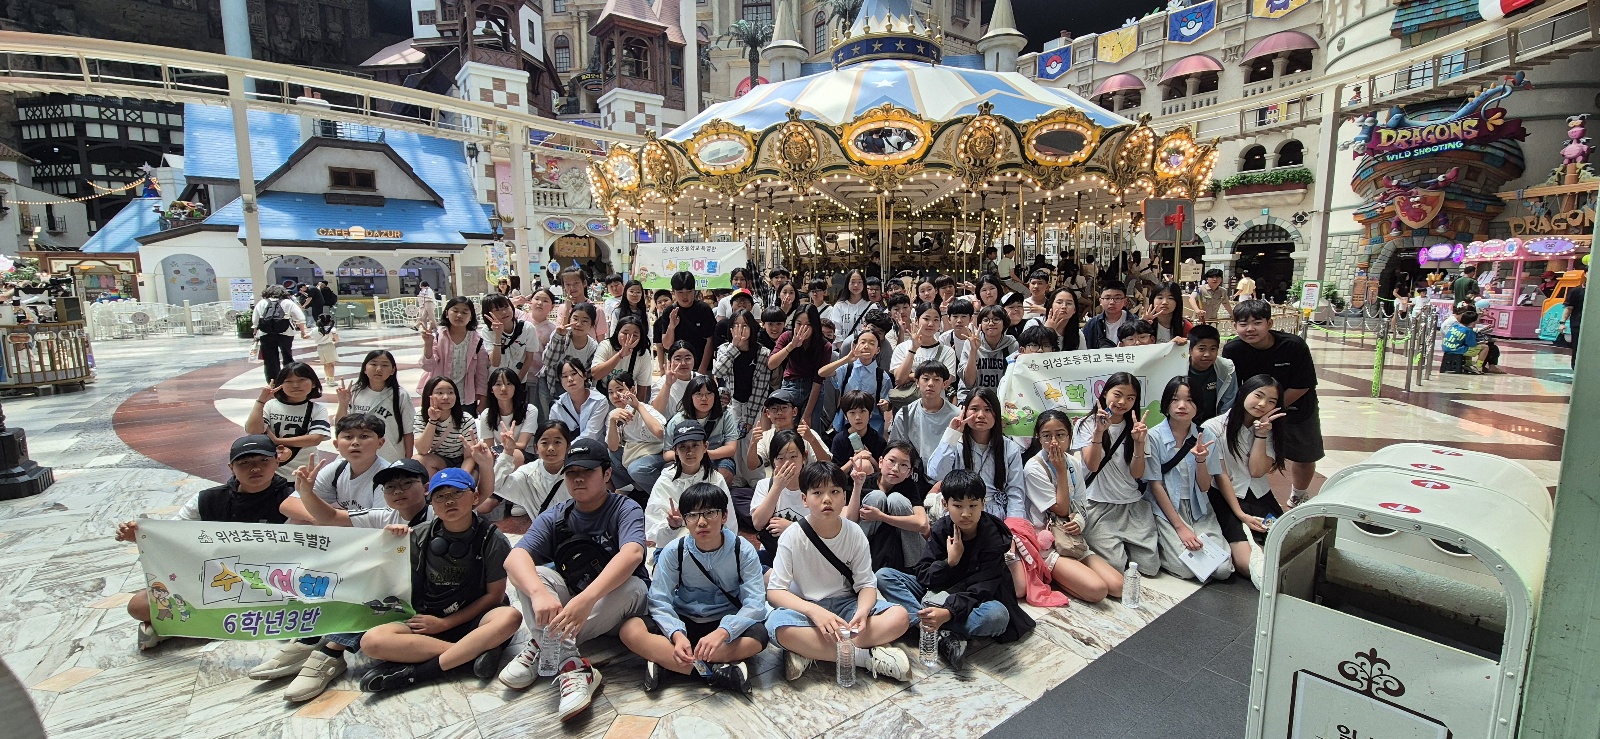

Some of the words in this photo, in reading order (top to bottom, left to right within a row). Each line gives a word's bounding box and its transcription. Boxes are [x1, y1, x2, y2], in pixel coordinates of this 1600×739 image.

[1376, 119, 1479, 149] DRAGONS
[1386, 150, 1411, 162] WILD
[1413, 141, 1464, 157] SHOOTING
[319, 227, 349, 237] CAFE
[1042, 353, 1102, 370] 위성초등학교
[1104, 352, 1136, 364] 특별한
[215, 529, 290, 544] 위성초등학교
[293, 531, 331, 551] 특별한
[224, 607, 321, 636] 6학년3반
